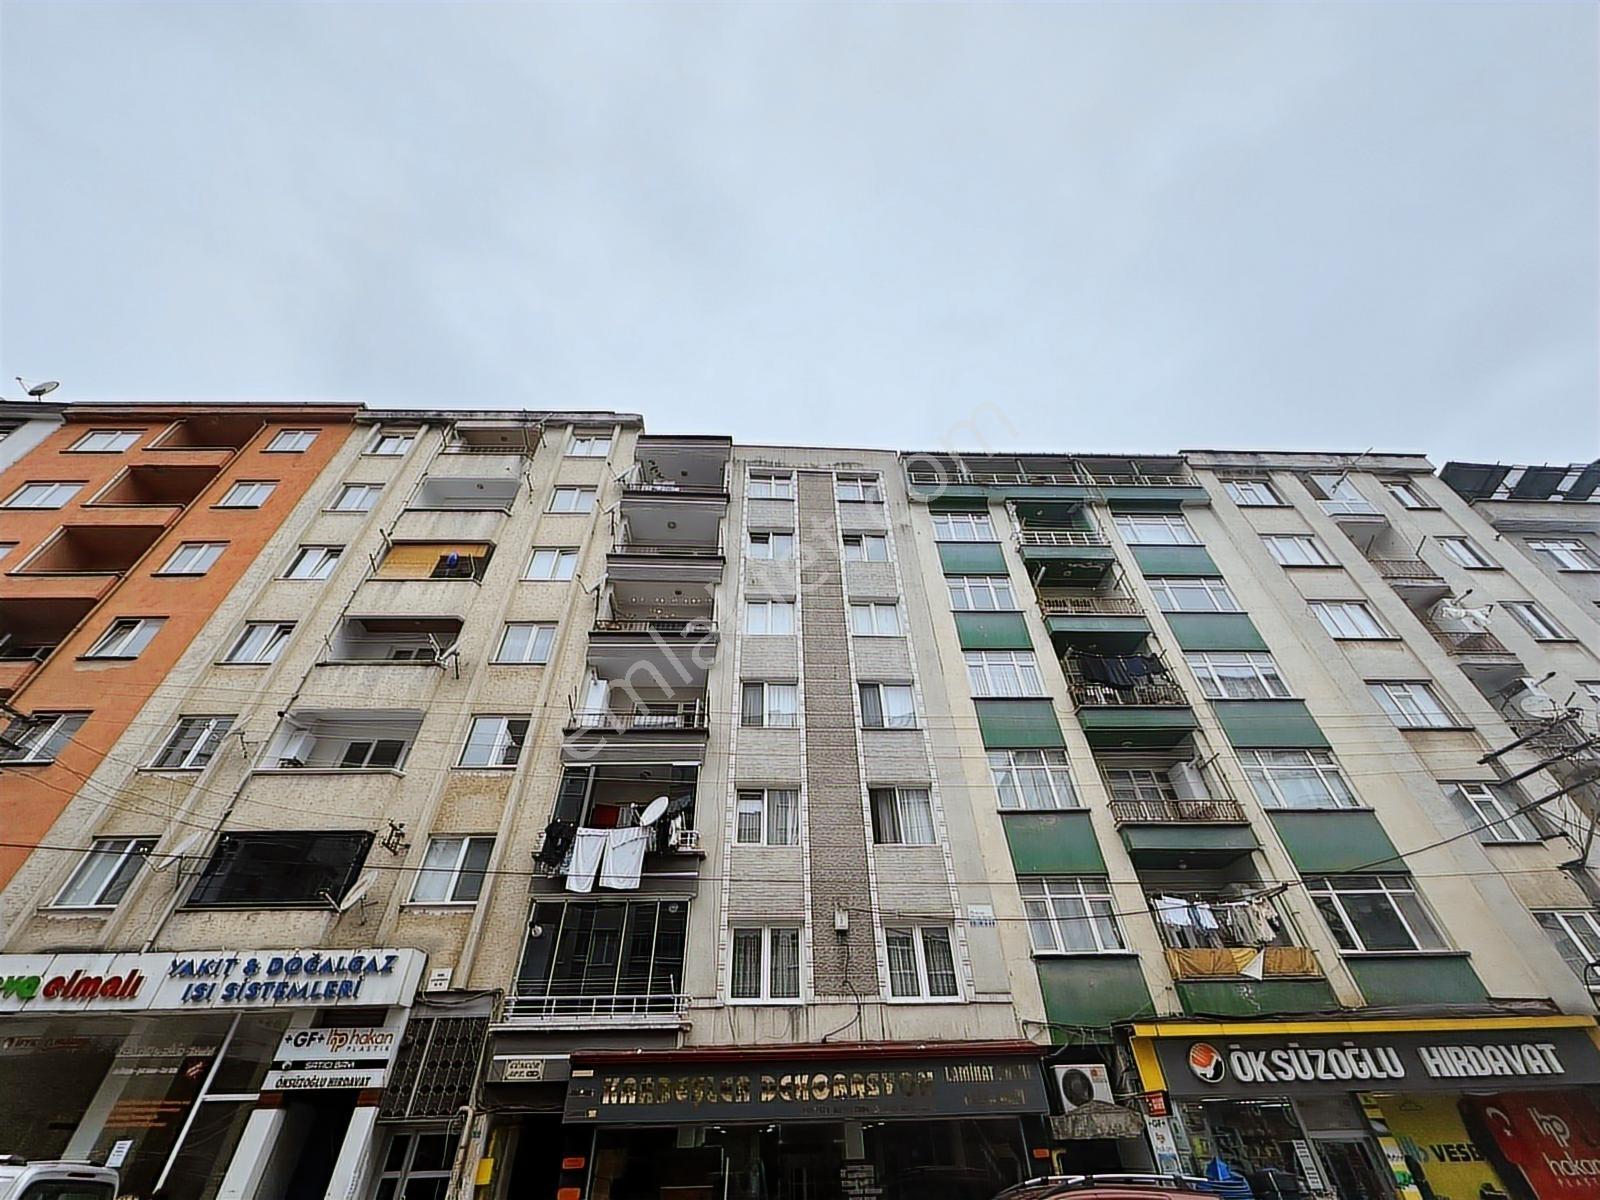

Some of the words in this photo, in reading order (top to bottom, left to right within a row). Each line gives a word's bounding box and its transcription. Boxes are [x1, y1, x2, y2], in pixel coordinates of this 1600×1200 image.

[169, 957, 239, 979] YAKIT
[243, 957, 262, 978] &
[266, 953, 398, 977] DOĞALGAZ
[42, 968, 146, 999] elmalı
[181, 982, 218, 1003] ISI
[221, 975, 365, 1001] SİSTEMLERİ
[350, 1028, 395, 1045] hakan
[1228, 1042, 1406, 1083] ÖKSÜZOĞLU
[1417, 1044, 1566, 1079] HIRDAVAT
